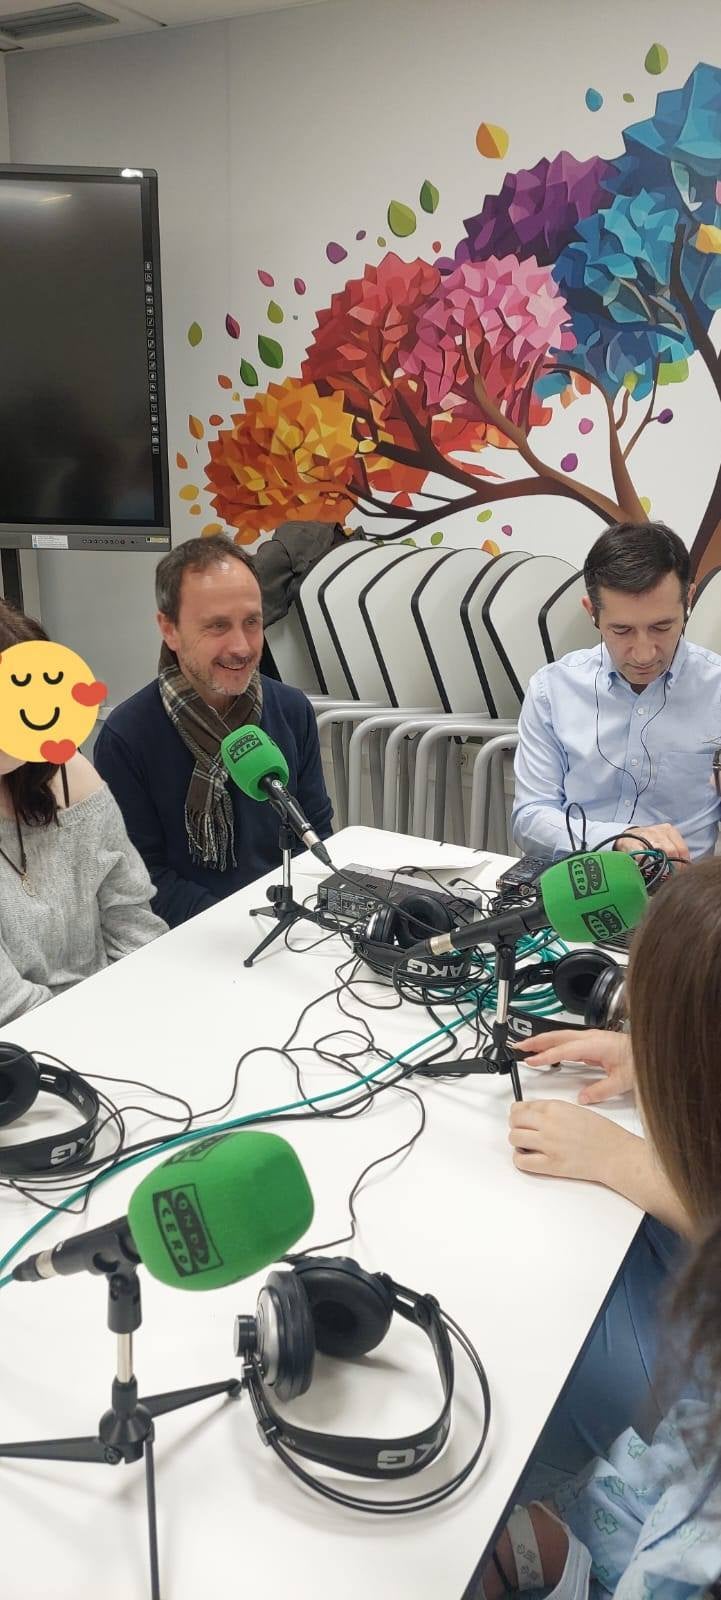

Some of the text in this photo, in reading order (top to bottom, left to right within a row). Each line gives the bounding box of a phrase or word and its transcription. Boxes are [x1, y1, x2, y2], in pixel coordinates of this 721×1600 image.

[574, 863, 586, 891] CERO
[588, 859, 599, 888] ONDA
[407, 958, 464, 977] AKG
[162, 1207, 188, 1264] CERO
[179, 1199, 206, 1261] ONDA
